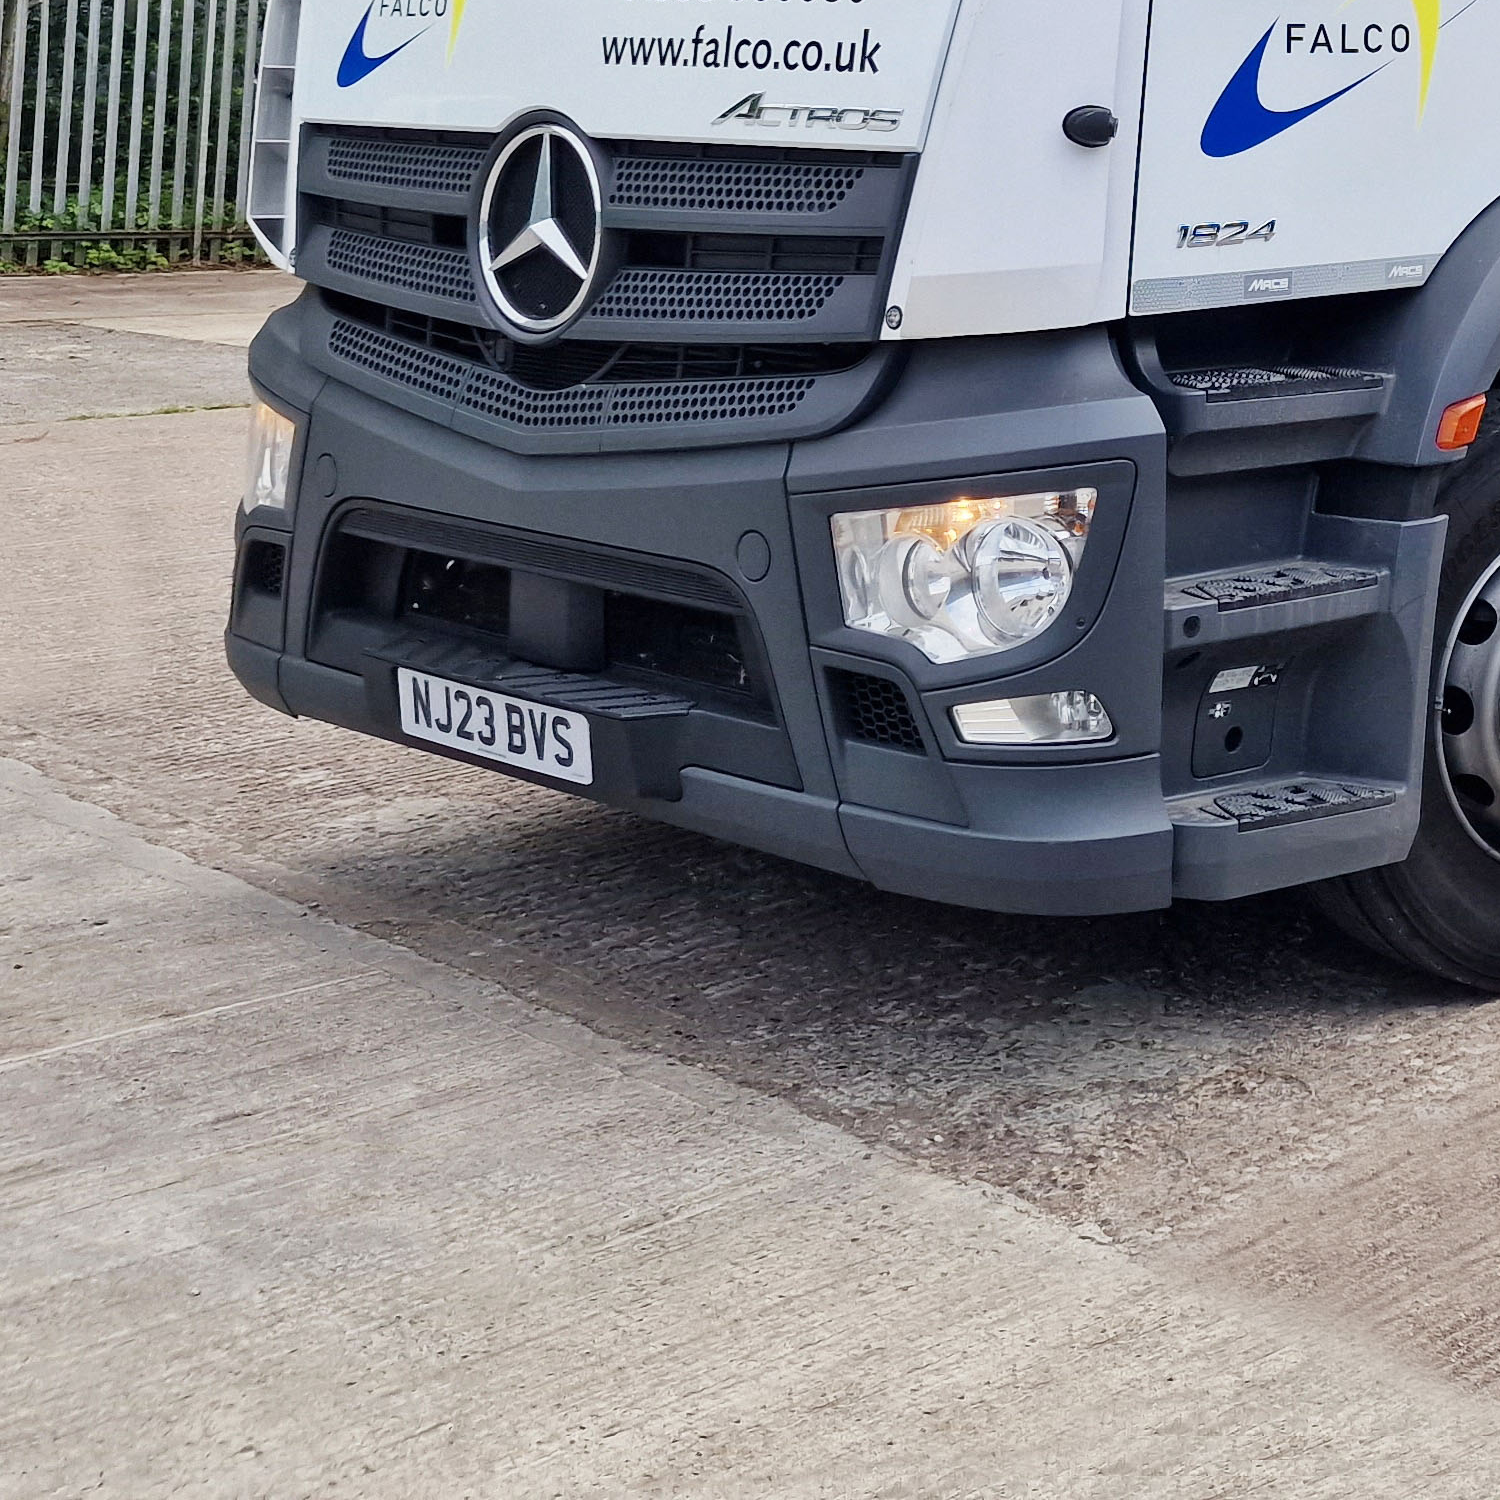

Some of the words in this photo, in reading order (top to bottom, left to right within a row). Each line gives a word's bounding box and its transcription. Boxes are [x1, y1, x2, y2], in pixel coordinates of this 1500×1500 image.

[601, 24, 882, 74] www.falco.co.uk
[1286, 23, 1411, 54] FALCO
[1176, 218, 1278, 249] 1824
[412, 677, 496, 747] NJ23
[505, 702, 574, 768] BVS
